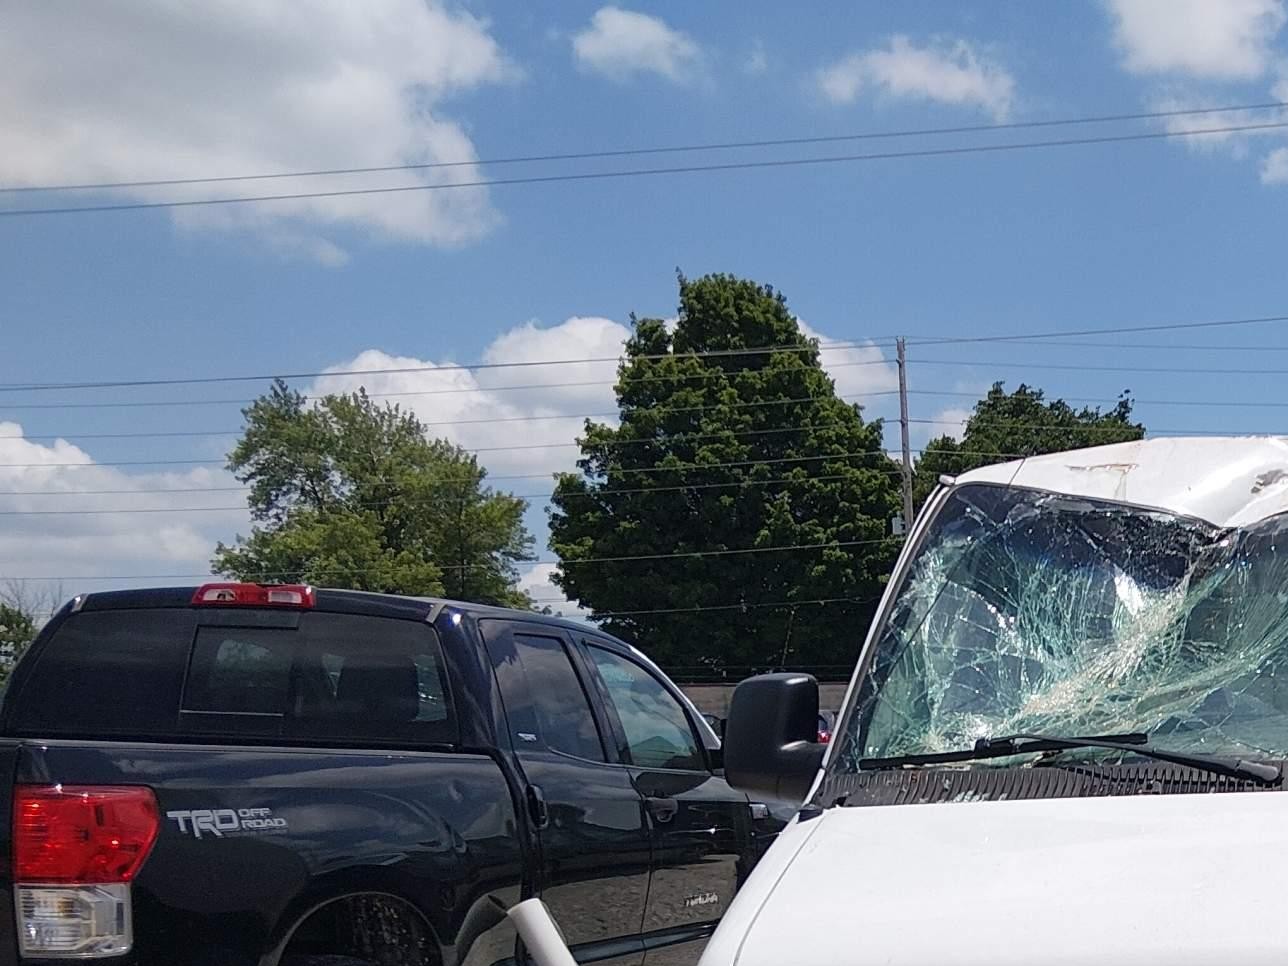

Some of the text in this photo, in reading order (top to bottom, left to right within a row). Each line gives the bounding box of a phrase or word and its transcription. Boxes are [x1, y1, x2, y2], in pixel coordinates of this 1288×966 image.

[167, 808, 271, 838] TRD OFF
[241, 818, 287, 828] ROAD
